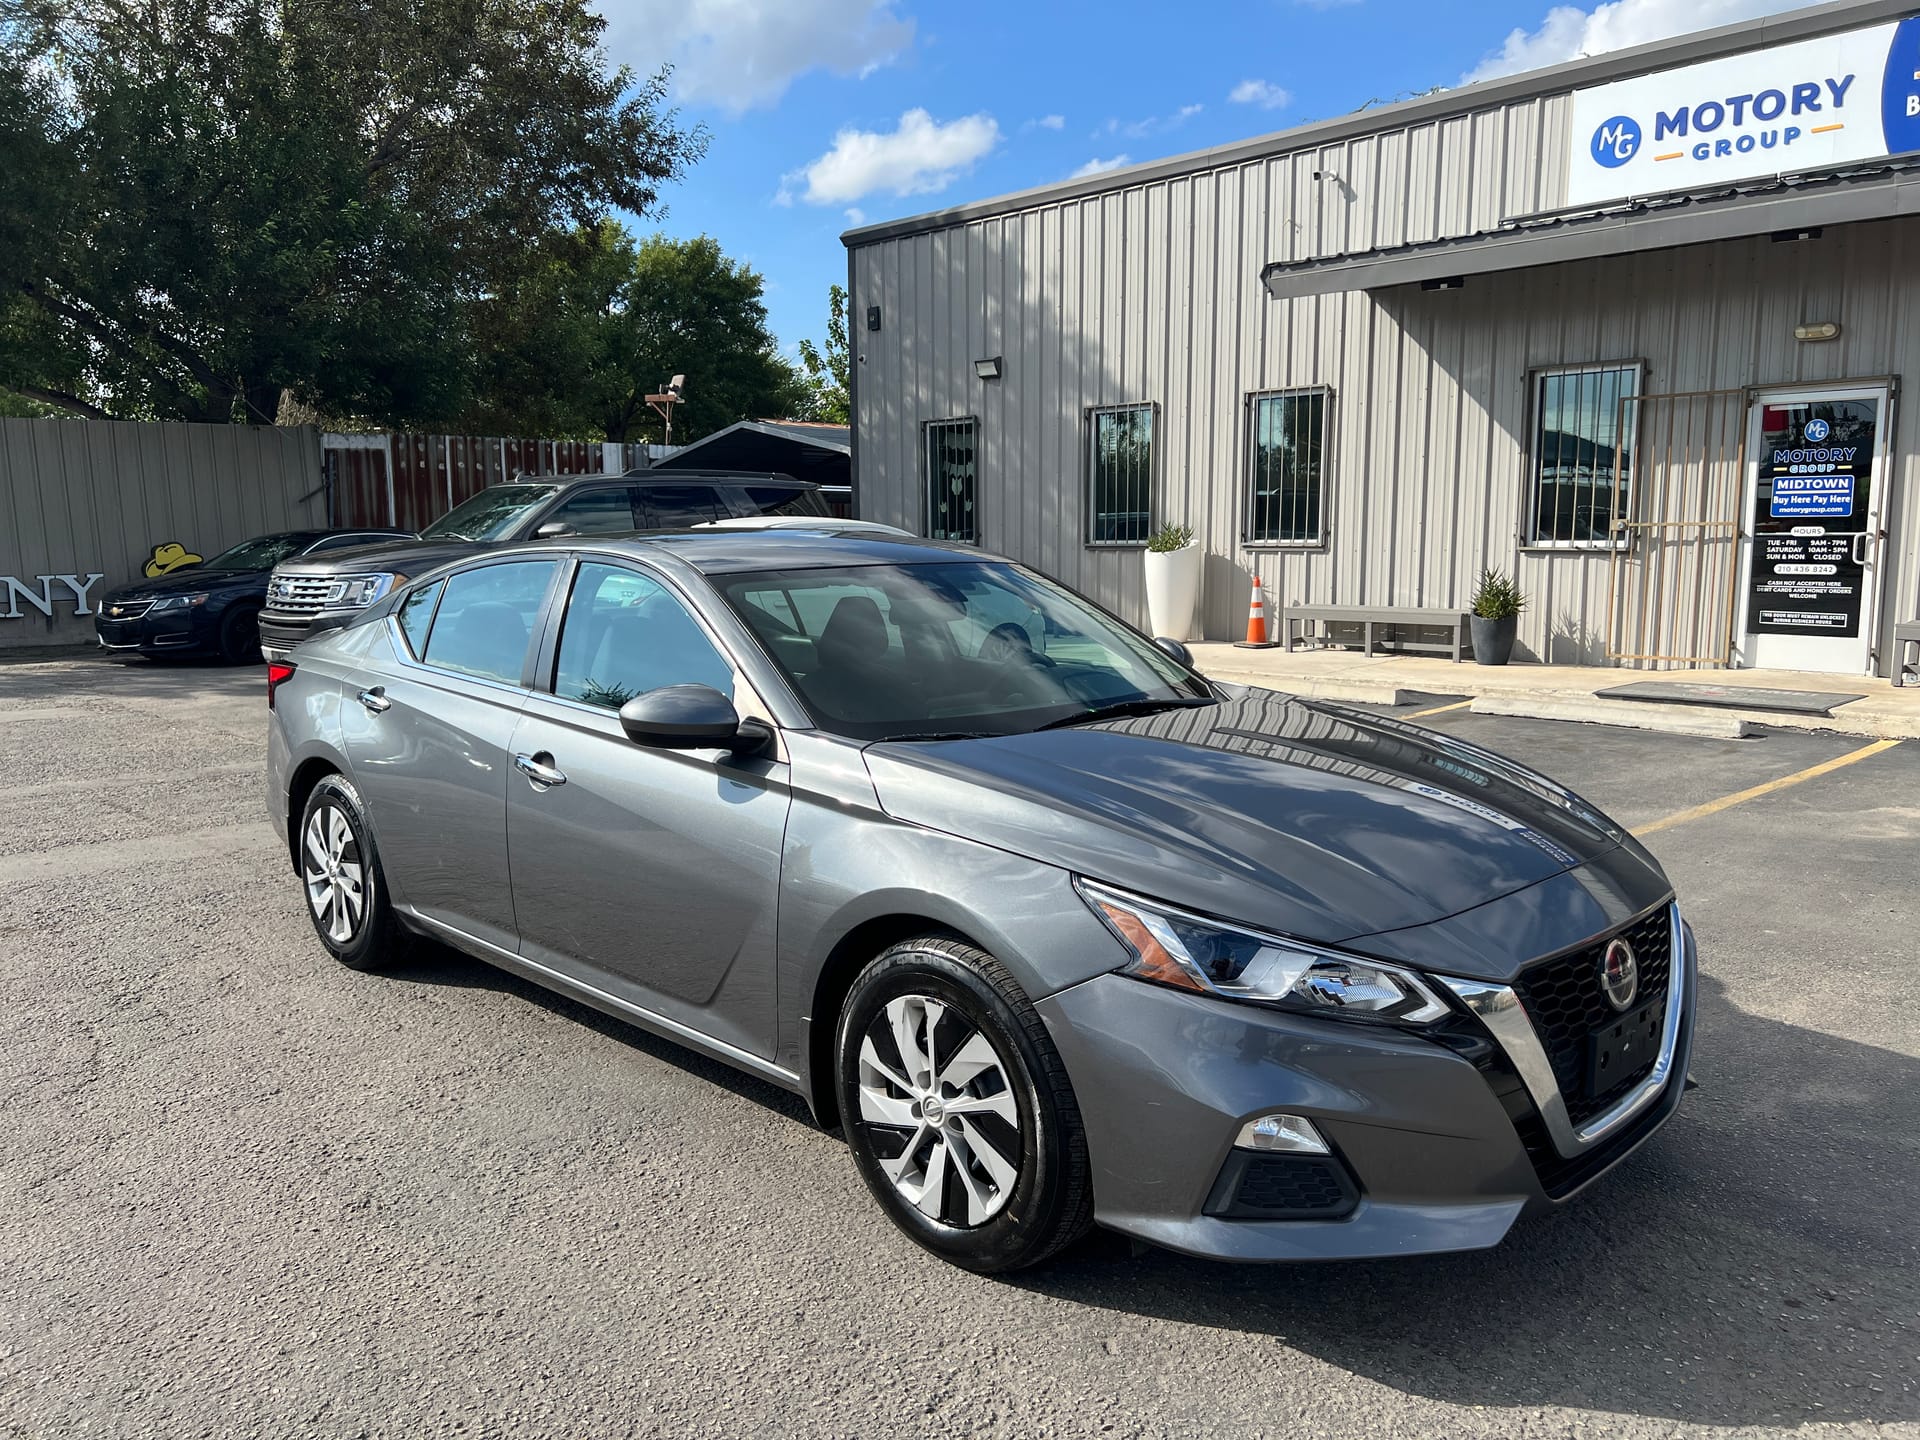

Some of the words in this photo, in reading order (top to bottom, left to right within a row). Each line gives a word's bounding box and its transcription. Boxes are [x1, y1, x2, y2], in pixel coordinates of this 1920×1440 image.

[1654, 74, 1855, 142] MOTORY
[1692, 126, 1801, 161] GROUP
[1773, 447, 1857, 463] MOTORY
[1789, 463, 1836, 473] GROUP
[1777, 478, 1849, 489] MIDTOWN
[1773, 495, 1789, 505] Buy
[1790, 495, 1811, 504] Here
[1812, 495, 1828, 505] Pay
[1829, 494, 1851, 503] Here
[1778, 506, 1843, 514] motorygroup.com
[0, 573, 104, 618] NY
